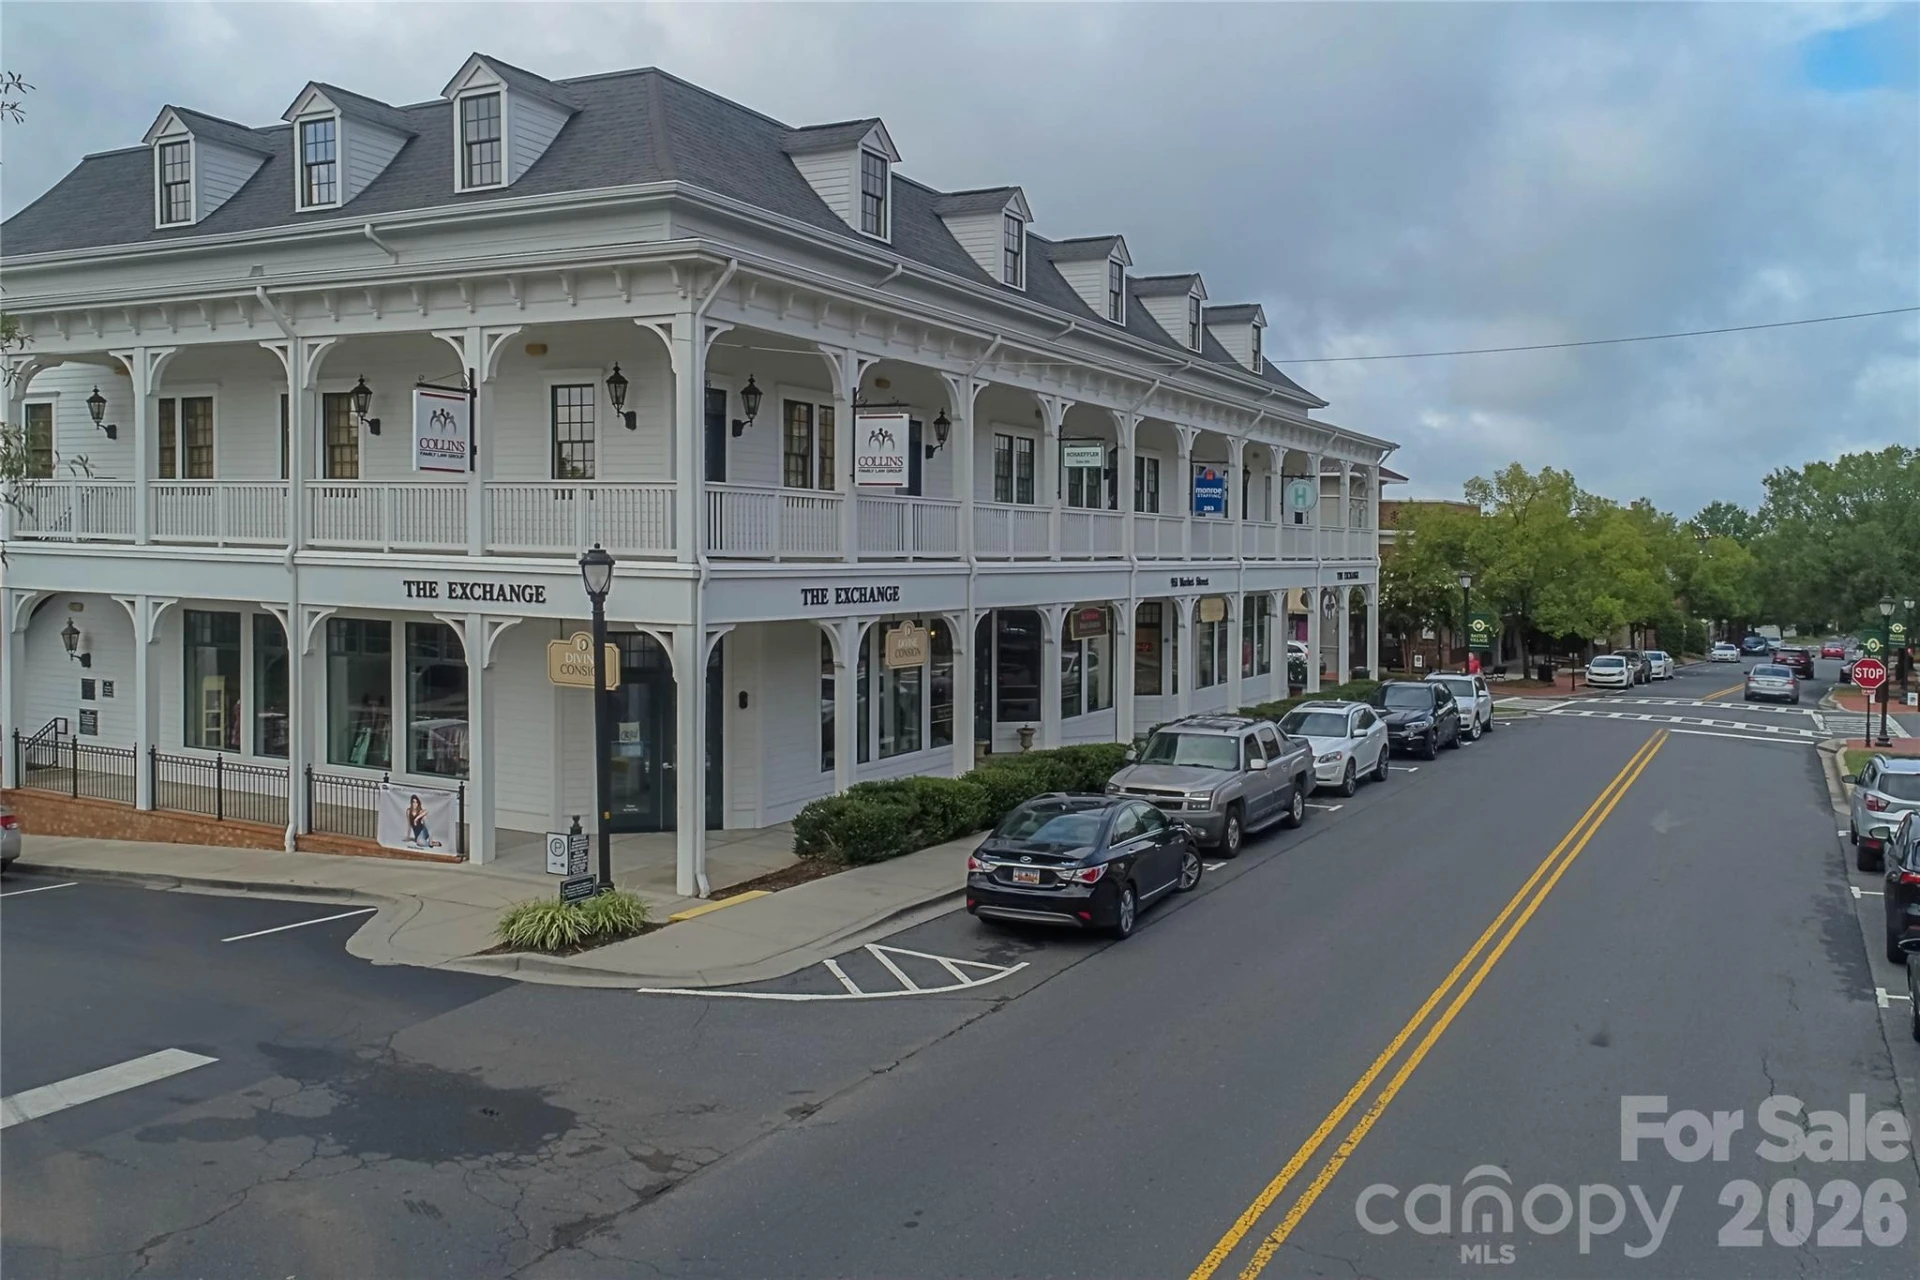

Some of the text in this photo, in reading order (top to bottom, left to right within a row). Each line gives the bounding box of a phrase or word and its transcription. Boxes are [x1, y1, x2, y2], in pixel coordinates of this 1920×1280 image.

[419, 437, 465, 453] COLLINS
[858, 456, 904, 467] COLLINS
[403, 580, 546, 604] THE EXCHANGE
[801, 585, 900, 606] THE EXCHANGE
[565, 652, 595, 665] DIVIN
[560, 663, 596, 677] CONSI
[1854, 667, 1884, 679] STOP
